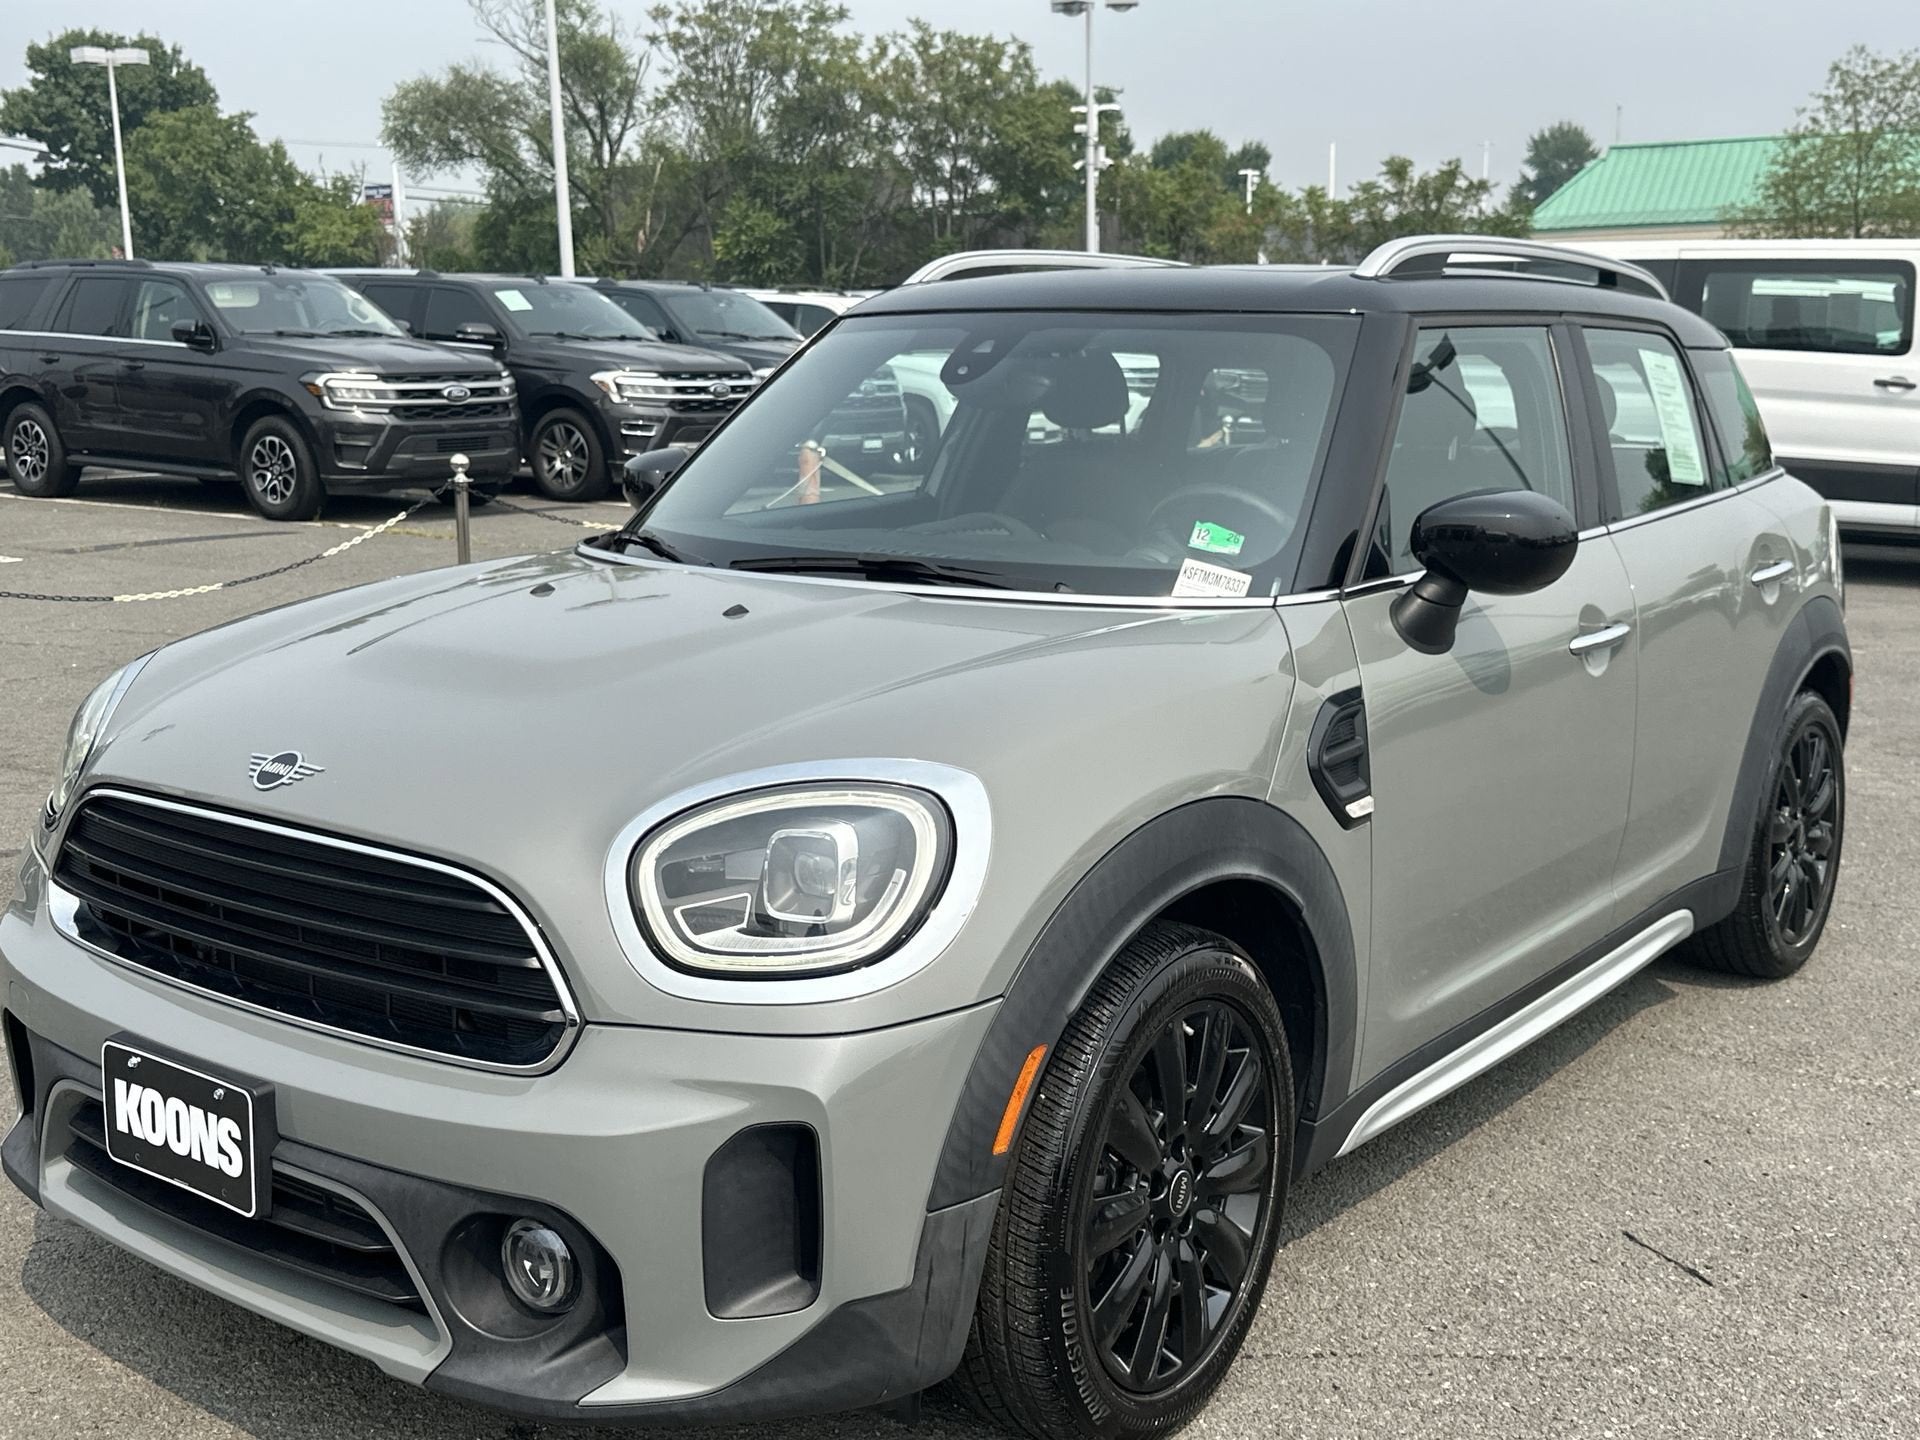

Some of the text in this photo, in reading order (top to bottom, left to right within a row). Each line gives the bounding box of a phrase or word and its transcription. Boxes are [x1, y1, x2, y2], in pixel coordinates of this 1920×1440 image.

[1196, 528, 1211, 541] 12
[262, 761, 293, 776] MINI
[114, 1078, 243, 1178] KOONS
[1175, 1176, 1188, 1209] MINI
